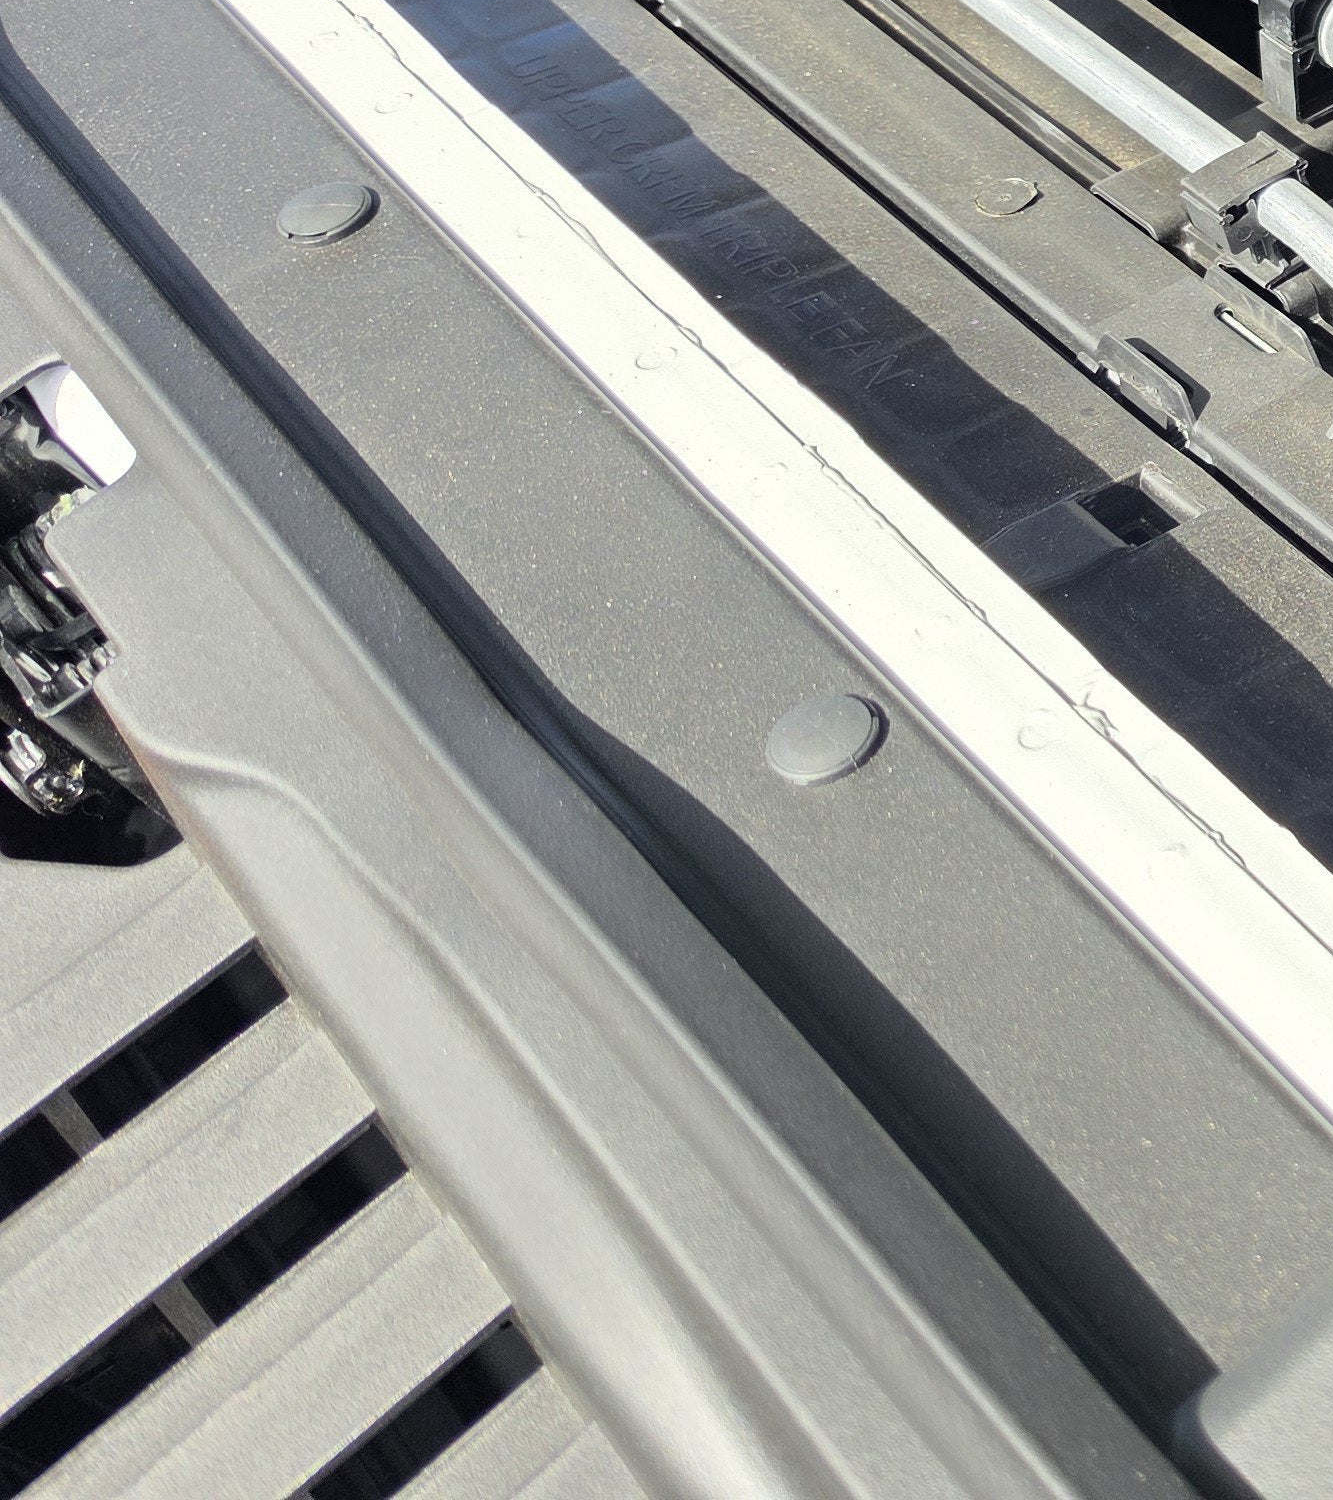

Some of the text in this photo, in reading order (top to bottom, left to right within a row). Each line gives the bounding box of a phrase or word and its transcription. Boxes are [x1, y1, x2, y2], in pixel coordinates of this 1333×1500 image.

[509, 54, 627, 142] UPPER
[701, 213, 840, 324] TRIPLE
[808, 317, 915, 389] FAN
